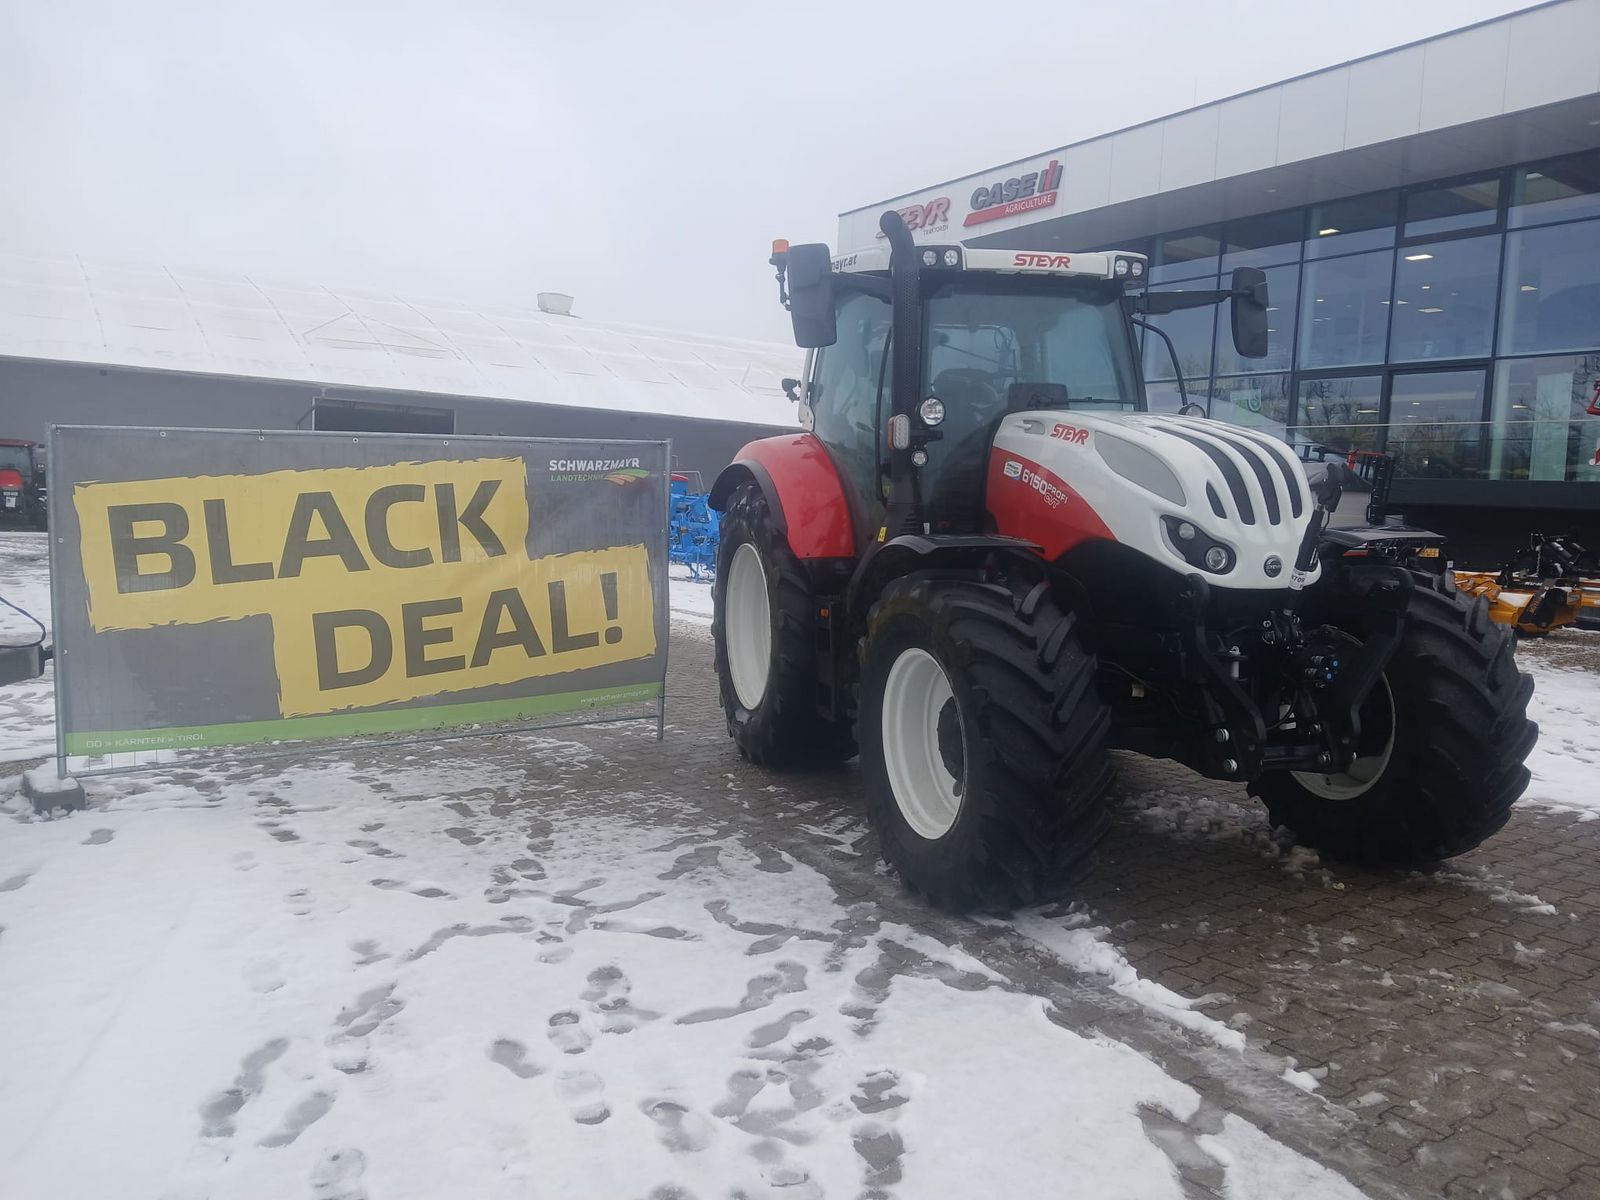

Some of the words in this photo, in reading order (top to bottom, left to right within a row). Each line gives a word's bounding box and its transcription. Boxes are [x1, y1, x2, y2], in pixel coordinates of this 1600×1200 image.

[1004, 194, 1052, 214] AGRICULTURE
[876, 197, 950, 239] EYR
[1013, 254, 1071, 269] STEYR
[1050, 423, 1089, 446] STEYR
[549, 457, 640, 471] SCHWARZMAYR
[1022, 469, 1048, 495] 6150
[1046, 483, 1068, 504] PROFI
[106, 480, 507, 594] BLACK
[312, 571, 623, 692] DEAL!
[176, 733, 207, 741] TIROL
